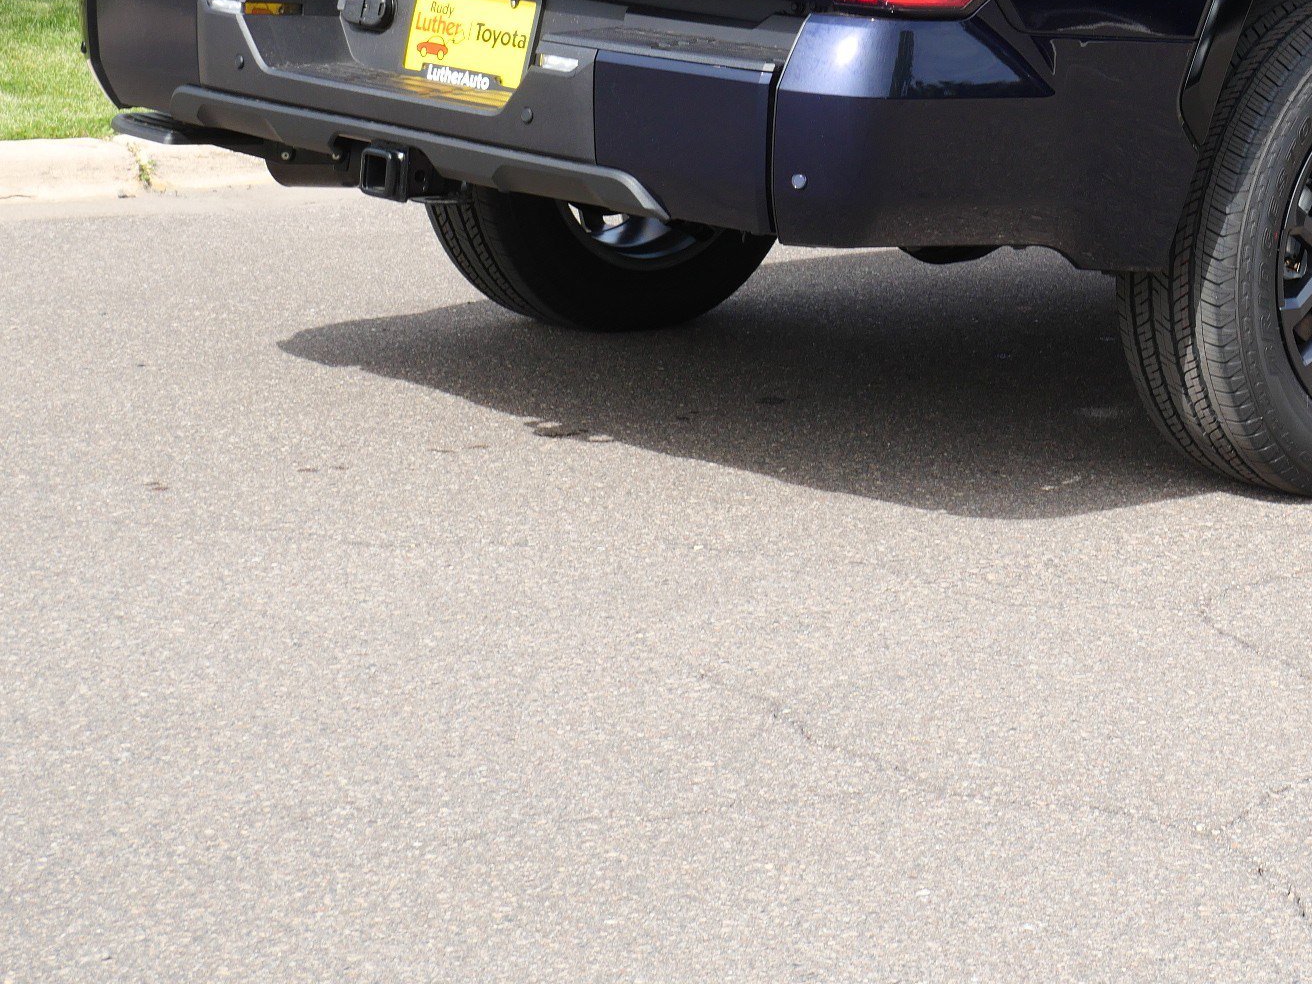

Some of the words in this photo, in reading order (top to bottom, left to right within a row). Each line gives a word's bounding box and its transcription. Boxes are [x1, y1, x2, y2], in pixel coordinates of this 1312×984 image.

[430, 1, 455, 18] Rudy
[415, 12, 462, 36] Luther
[476, 22, 527, 49] Toyota
[426, 64, 490, 91] LutherAuto
